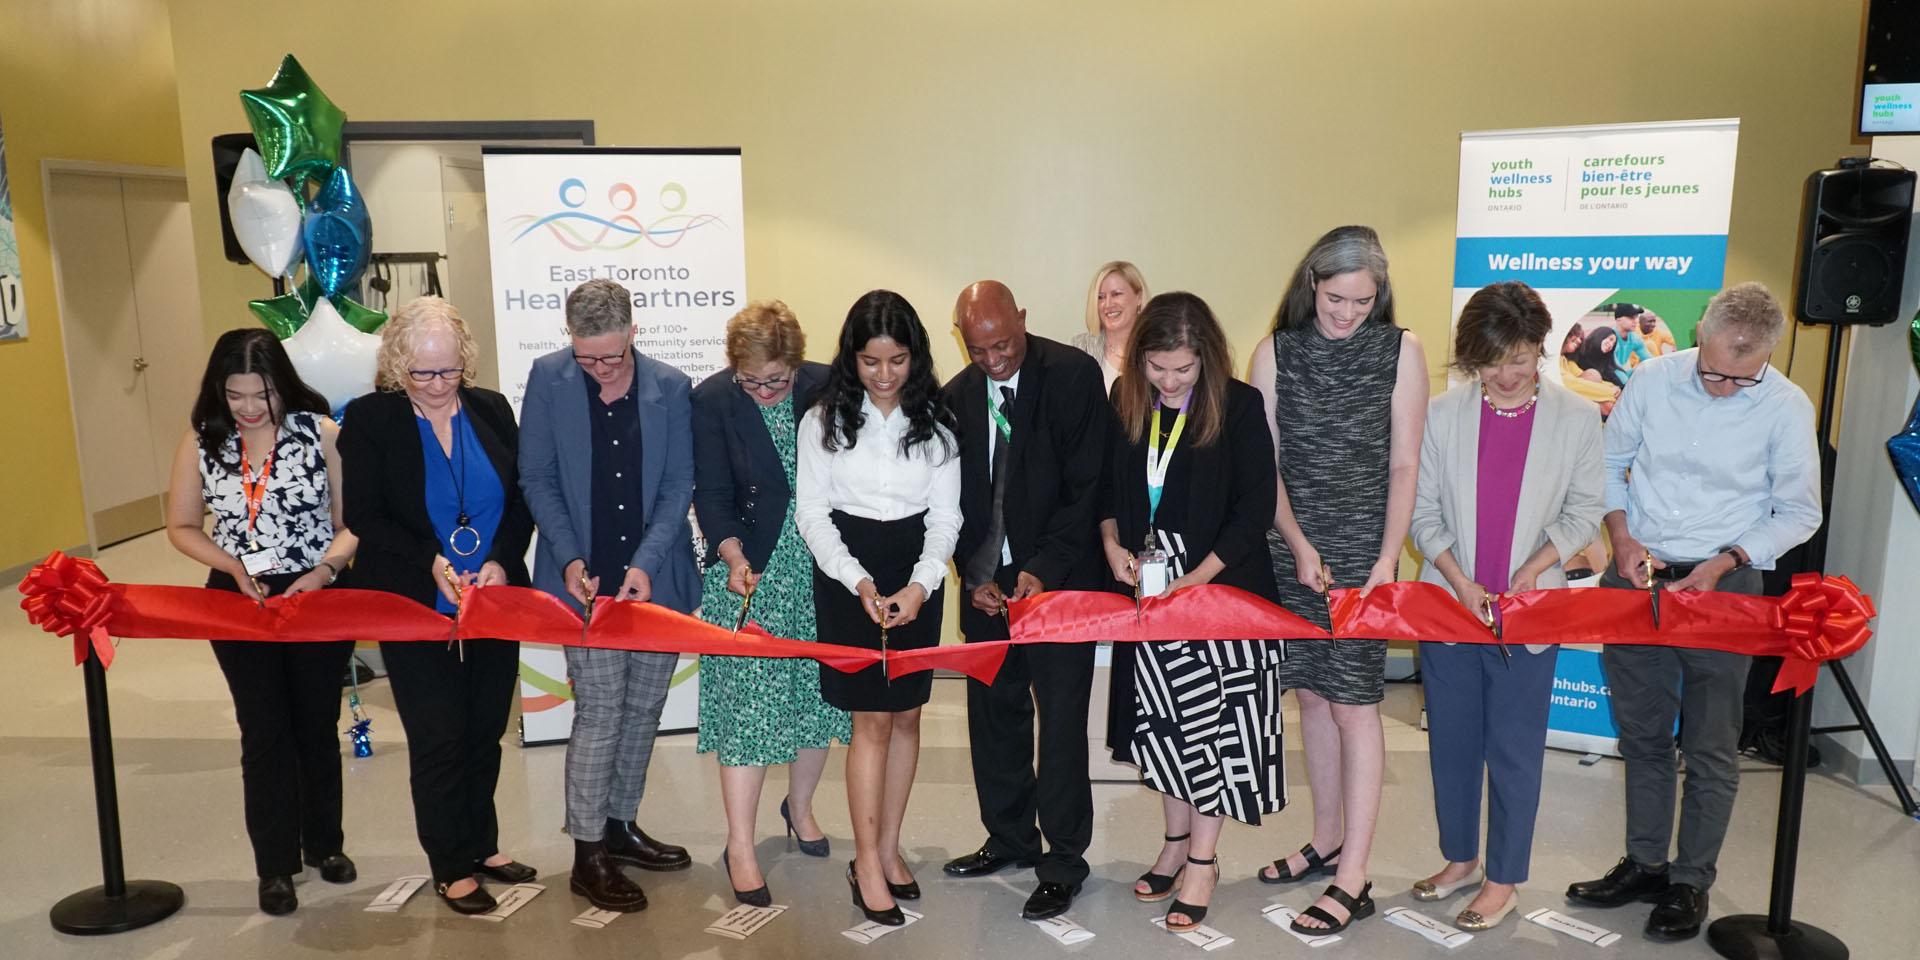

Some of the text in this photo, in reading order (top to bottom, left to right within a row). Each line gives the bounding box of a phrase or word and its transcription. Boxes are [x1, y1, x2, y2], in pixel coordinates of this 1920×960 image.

[1873, 94, 1901, 103] youth
[1491, 158, 1533, 173] youth
[1583, 153, 1665, 168] carrefours
[1490, 172, 1553, 185] wellness
[1582, 170, 1653, 183] bien-être
[1488, 186, 1523, 199] hubs
[1580, 183, 1700, 200] pour les jeunes
[1487, 204, 1522, 212] ONTARIO
[1488, 252, 1693, 275] Wellness your way
[549, 264, 690, 282] East Toronto
[633, 288, 735, 308] artners
[649, 325, 660, 333] of
[664, 325, 688, 333] 100+
